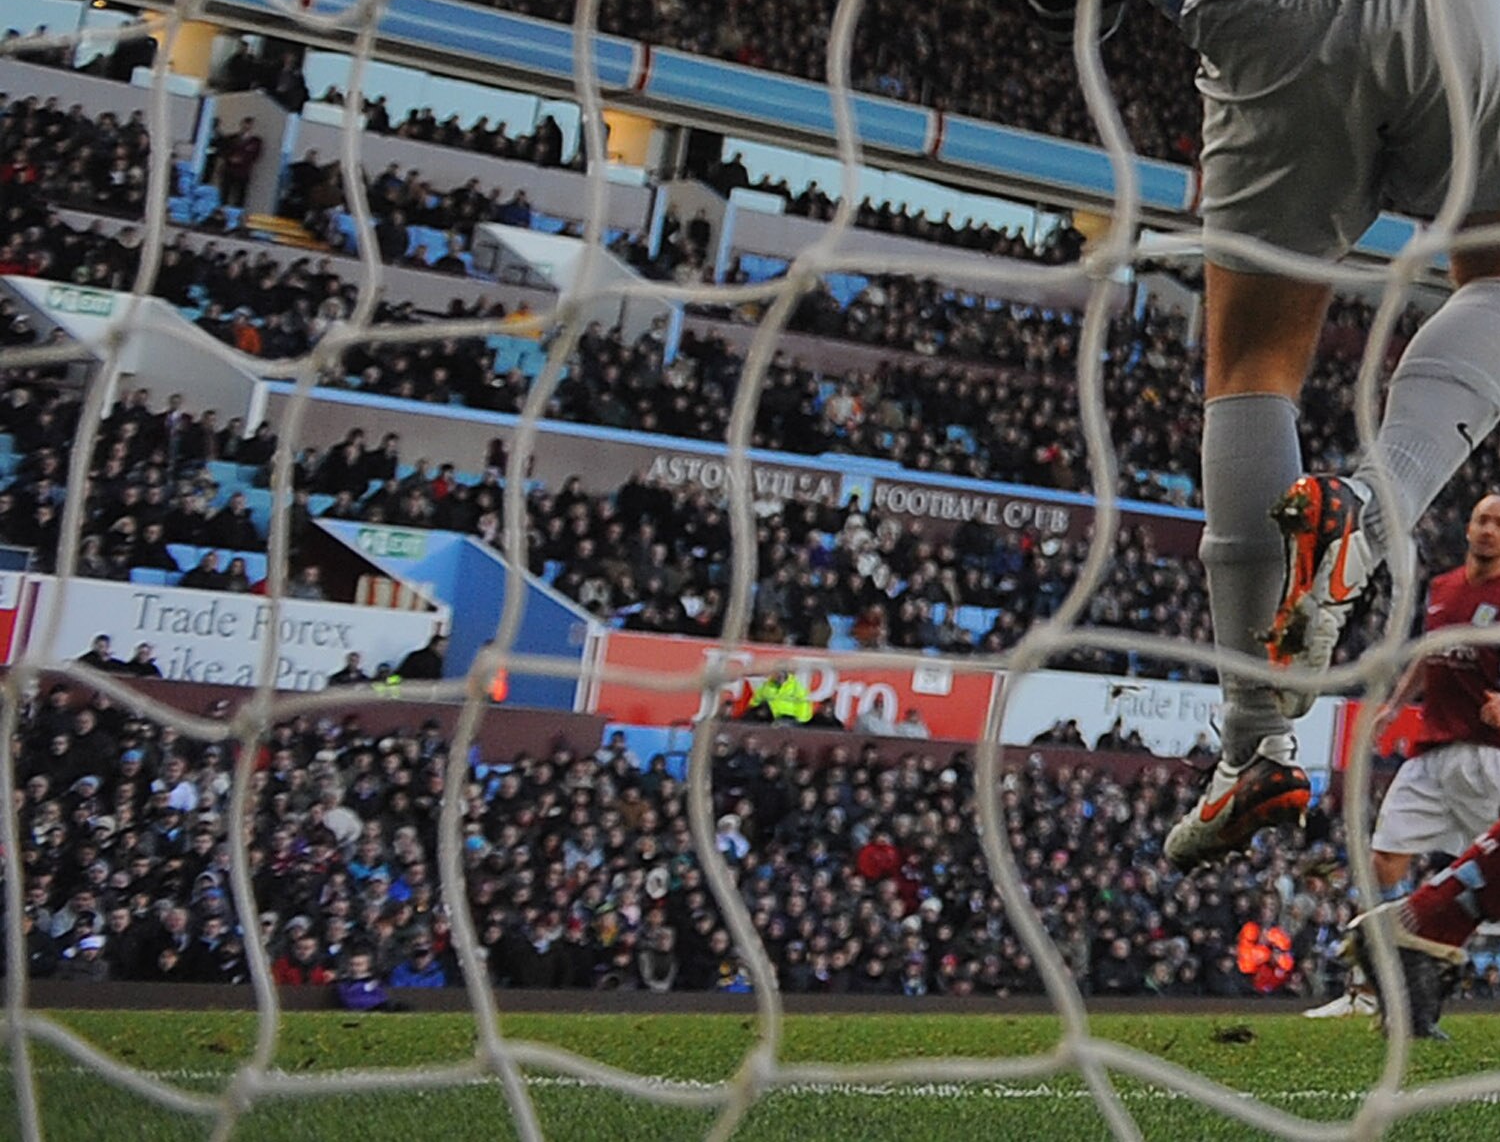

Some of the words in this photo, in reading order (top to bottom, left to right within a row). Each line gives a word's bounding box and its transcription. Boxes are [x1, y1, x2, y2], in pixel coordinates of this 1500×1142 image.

[132, 592, 238, 638] Trade
[248, 604, 352, 650] Forex
[167, 643, 224, 684] ike
